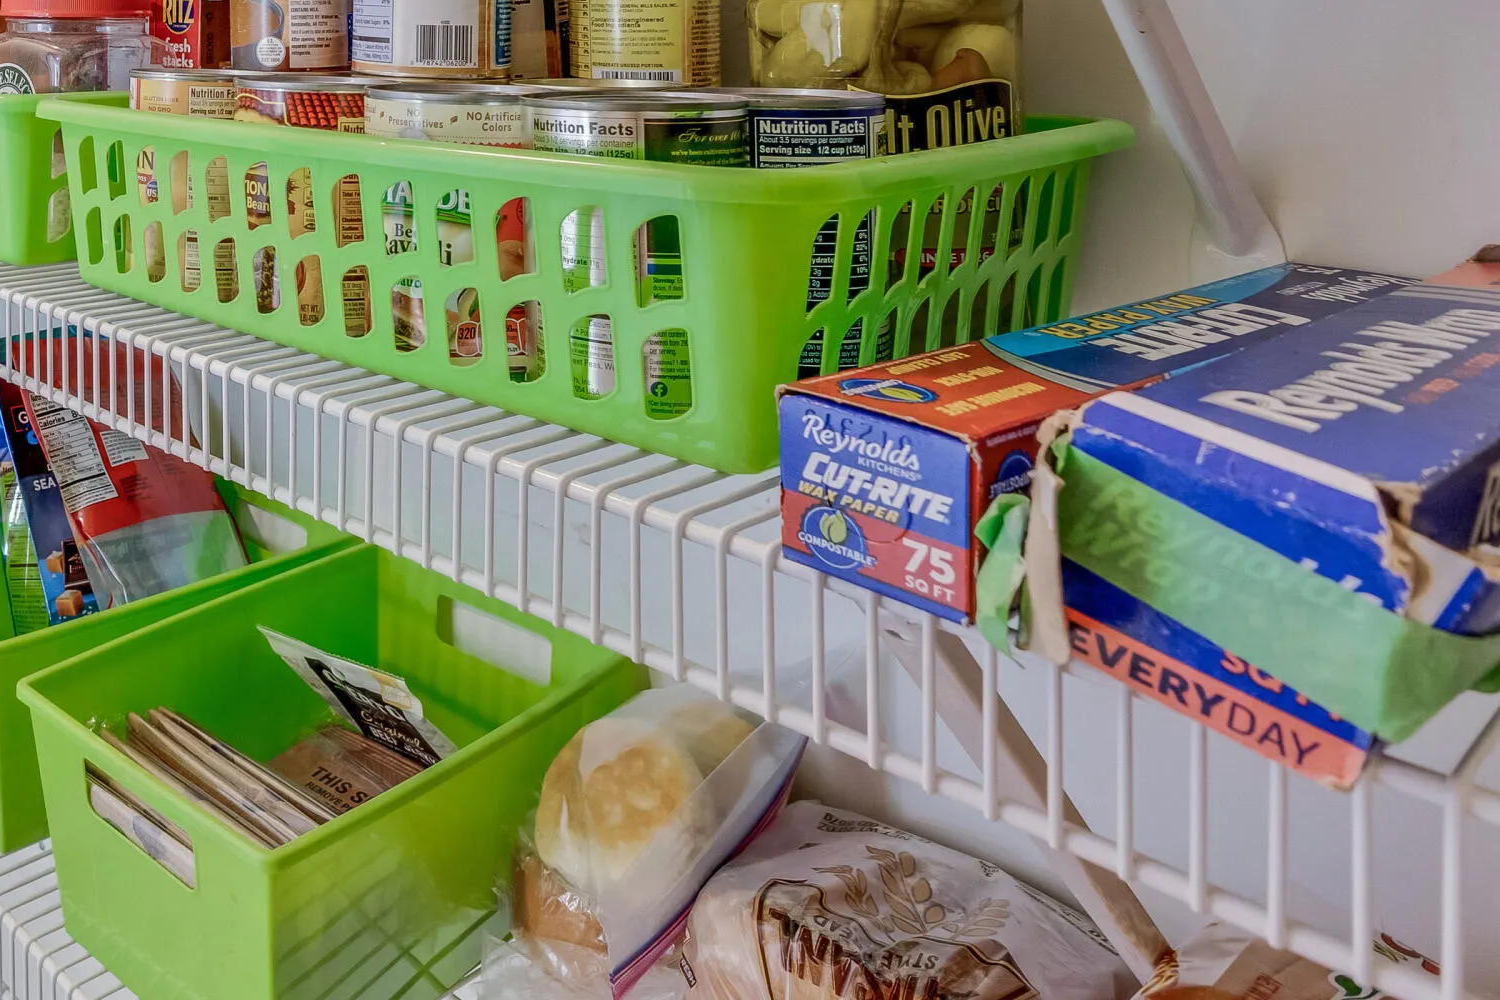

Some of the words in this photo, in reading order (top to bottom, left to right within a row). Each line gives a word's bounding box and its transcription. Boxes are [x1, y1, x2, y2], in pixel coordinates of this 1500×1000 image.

[165, 37, 191, 53] fresh
[163, 53, 194, 68] stacks
[190, 88, 222, 99] Nutrition
[190, 107, 206, 116] Serving
[466, 111, 482, 121] NO
[484, 111, 522, 122] Artificia
[388, 115, 444, 129] Presertives
[481, 122, 512, 132] Colors
[533, 118, 585, 135] Nutrition
[589, 121, 634, 137] Facts
[759, 120, 828, 135] Nutrition
[830, 120, 865, 134] Facts
[926, 98, 1006, 150] Olive
[678, 128, 707, 143] For
[708, 132, 730, 142] over
[791, 137, 817, 145] servings
[759, 145, 792, 156] Serving
[794, 146, 811, 154] size
[817, 146, 829, 154] 1/2
[830, 146, 845, 156] cup
[846, 145, 866, 155] (130g)
[246, 195, 271, 211] Bean
[1136, 292, 1217, 321] WAX
[457, 326, 477, 341] 320
[1037, 309, 1145, 341] PAPER
[1087, 301, 1311, 361] CUT-RITE
[1199, 341, 1453, 434] Reynolds
[38, 415, 66, 428] Calories
[802, 413, 921, 472] Reynolds
[33, 477, 57, 491] SEA
[802, 451, 954, 525] CUT-RITE
[797, 479, 837, 503] WAX
[839, 494, 900, 525] PAPER
[901, 537, 956, 585] 75
[904, 574, 929, 592] SQ
[932, 581, 956, 603] FT
[1067, 620, 1322, 767] EVERYDAY
[360, 709, 422, 748] Original
[311, 766, 352, 795] THIS
[305, 780, 342, 806] REMOVE
[879, 950, 940, 971] STYLE
